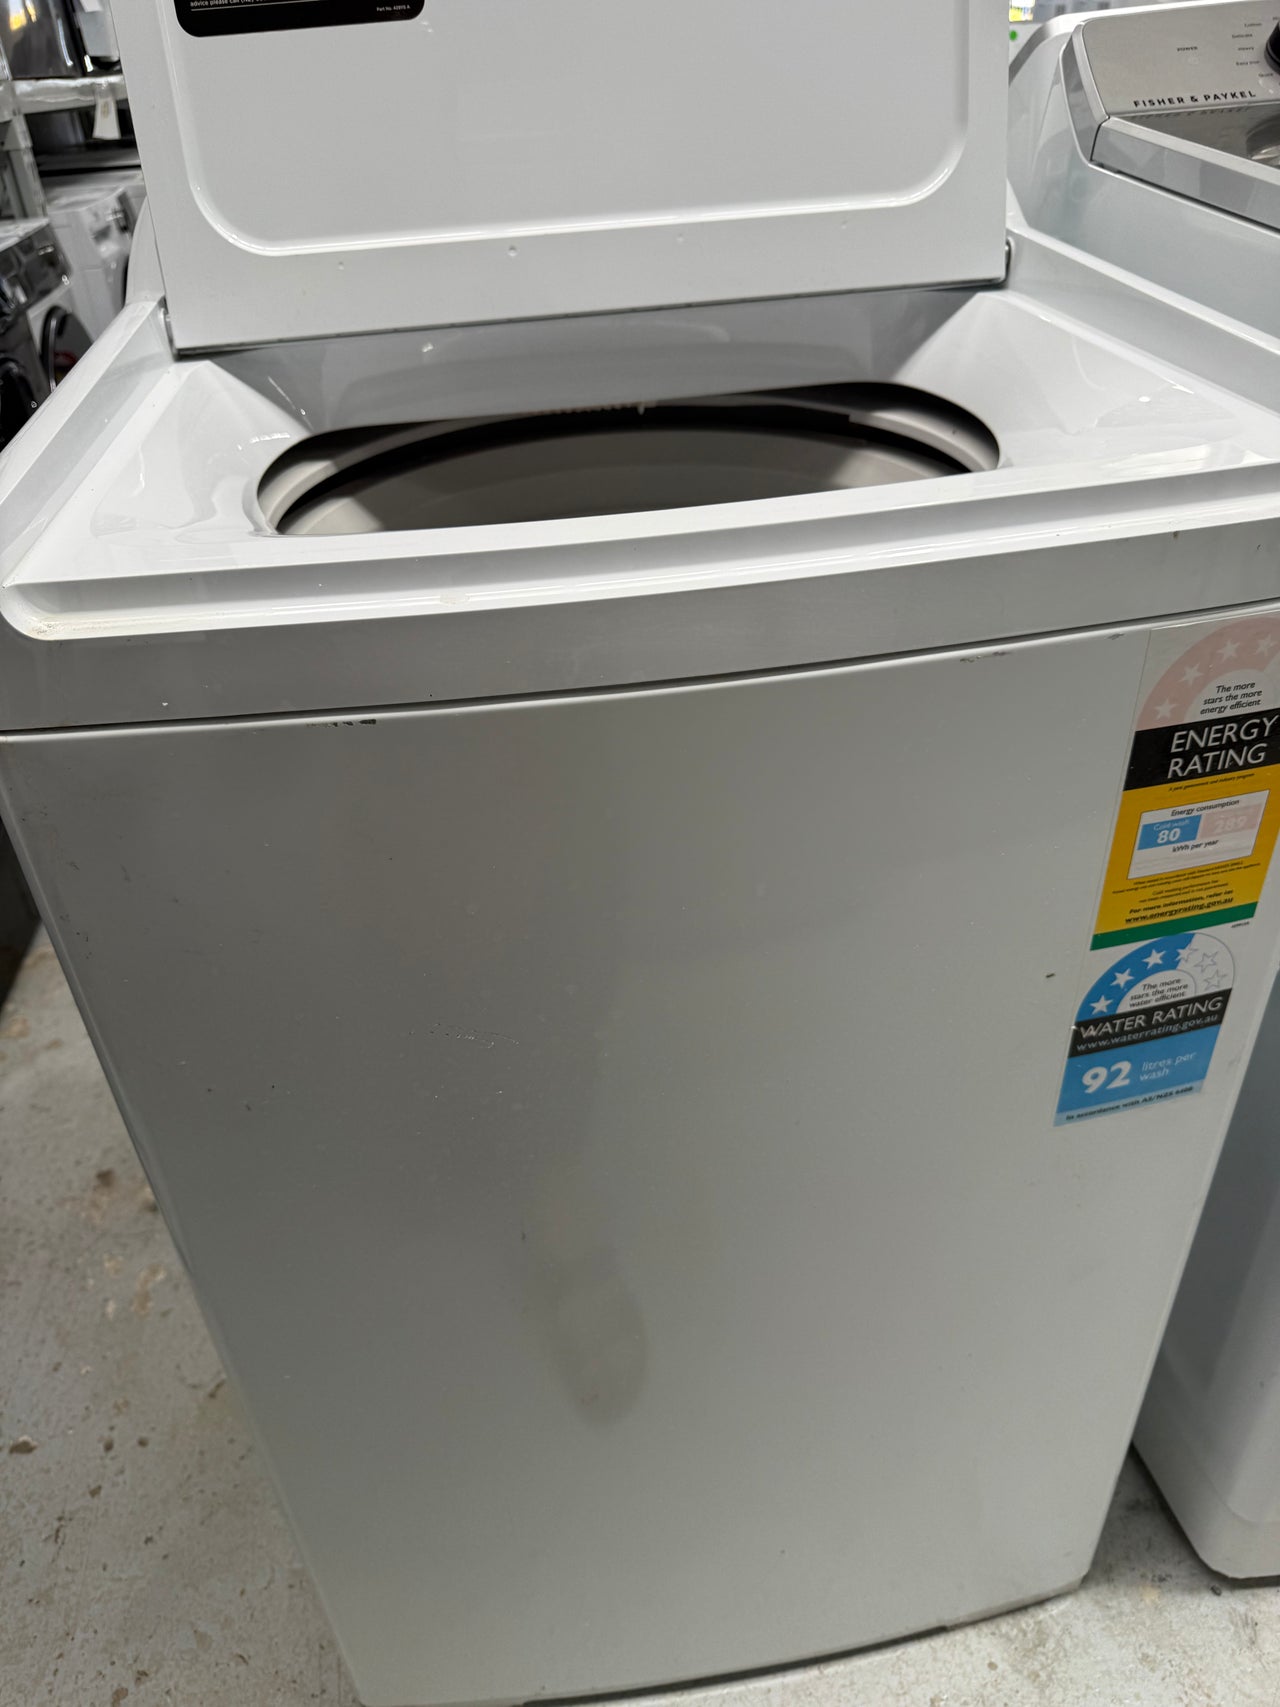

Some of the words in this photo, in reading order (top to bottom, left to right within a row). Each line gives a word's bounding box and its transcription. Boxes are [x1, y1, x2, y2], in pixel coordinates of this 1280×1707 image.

[1133, 96, 1185, 108] FISHER
[1190, 95, 1199, 103] &
[1203, 90, 1256, 102] PAYKEL
[1216, 684, 1232, 694] The
[1233, 682, 1256, 691] more
[1203, 695, 1223, 705] stars
[1225, 692, 1239, 702] the
[1240, 690, 1263, 699] more
[1200, 704, 1228, 715] energy
[1229, 699, 1261, 710] efficient
[1170, 714, 1280, 753] ENERGY
[1167, 743, 1268, 779] RATING
[1170, 808, 1195, 818] Energy
[1196, 799, 1240, 812] consumption
[1153, 822, 1171, 831] Cold
[1172, 818, 1191, 828] wash
[1213, 815, 1248, 833] 289
[1156, 828, 1181, 844] 80
[1172, 844, 1189, 852] kWh
[1190, 842, 1202, 850] per
[1203, 839, 1219, 848] year
[1206, 891, 1223, 899] refer
[1125, 897, 1234, 923] www.energyrating.gov.au
[1130, 993, 1149, 1001] stars
[1152, 988, 1165, 997] the
[1166, 984, 1188, 993] more
[1143, 983, 1158, 991] The
[1159, 978, 1181, 987] more
[1129, 999, 1152, 1008] water
[1154, 991, 1185, 1002] efficient
[1080, 1014, 1146, 1039] WATER
[1152, 996, 1223, 1024] RATING
[1076, 1014, 1218, 1051] www.waterrating.gov.au
[1141, 1058, 1171, 1072] litres
[1174, 1052, 1197, 1066] per
[1081, 1060, 1132, 1094] 92
[1139, 1068, 1169, 1081] wash
[1076, 1105, 1120, 1119] accordance
[1122, 1100, 1140, 1108] with
